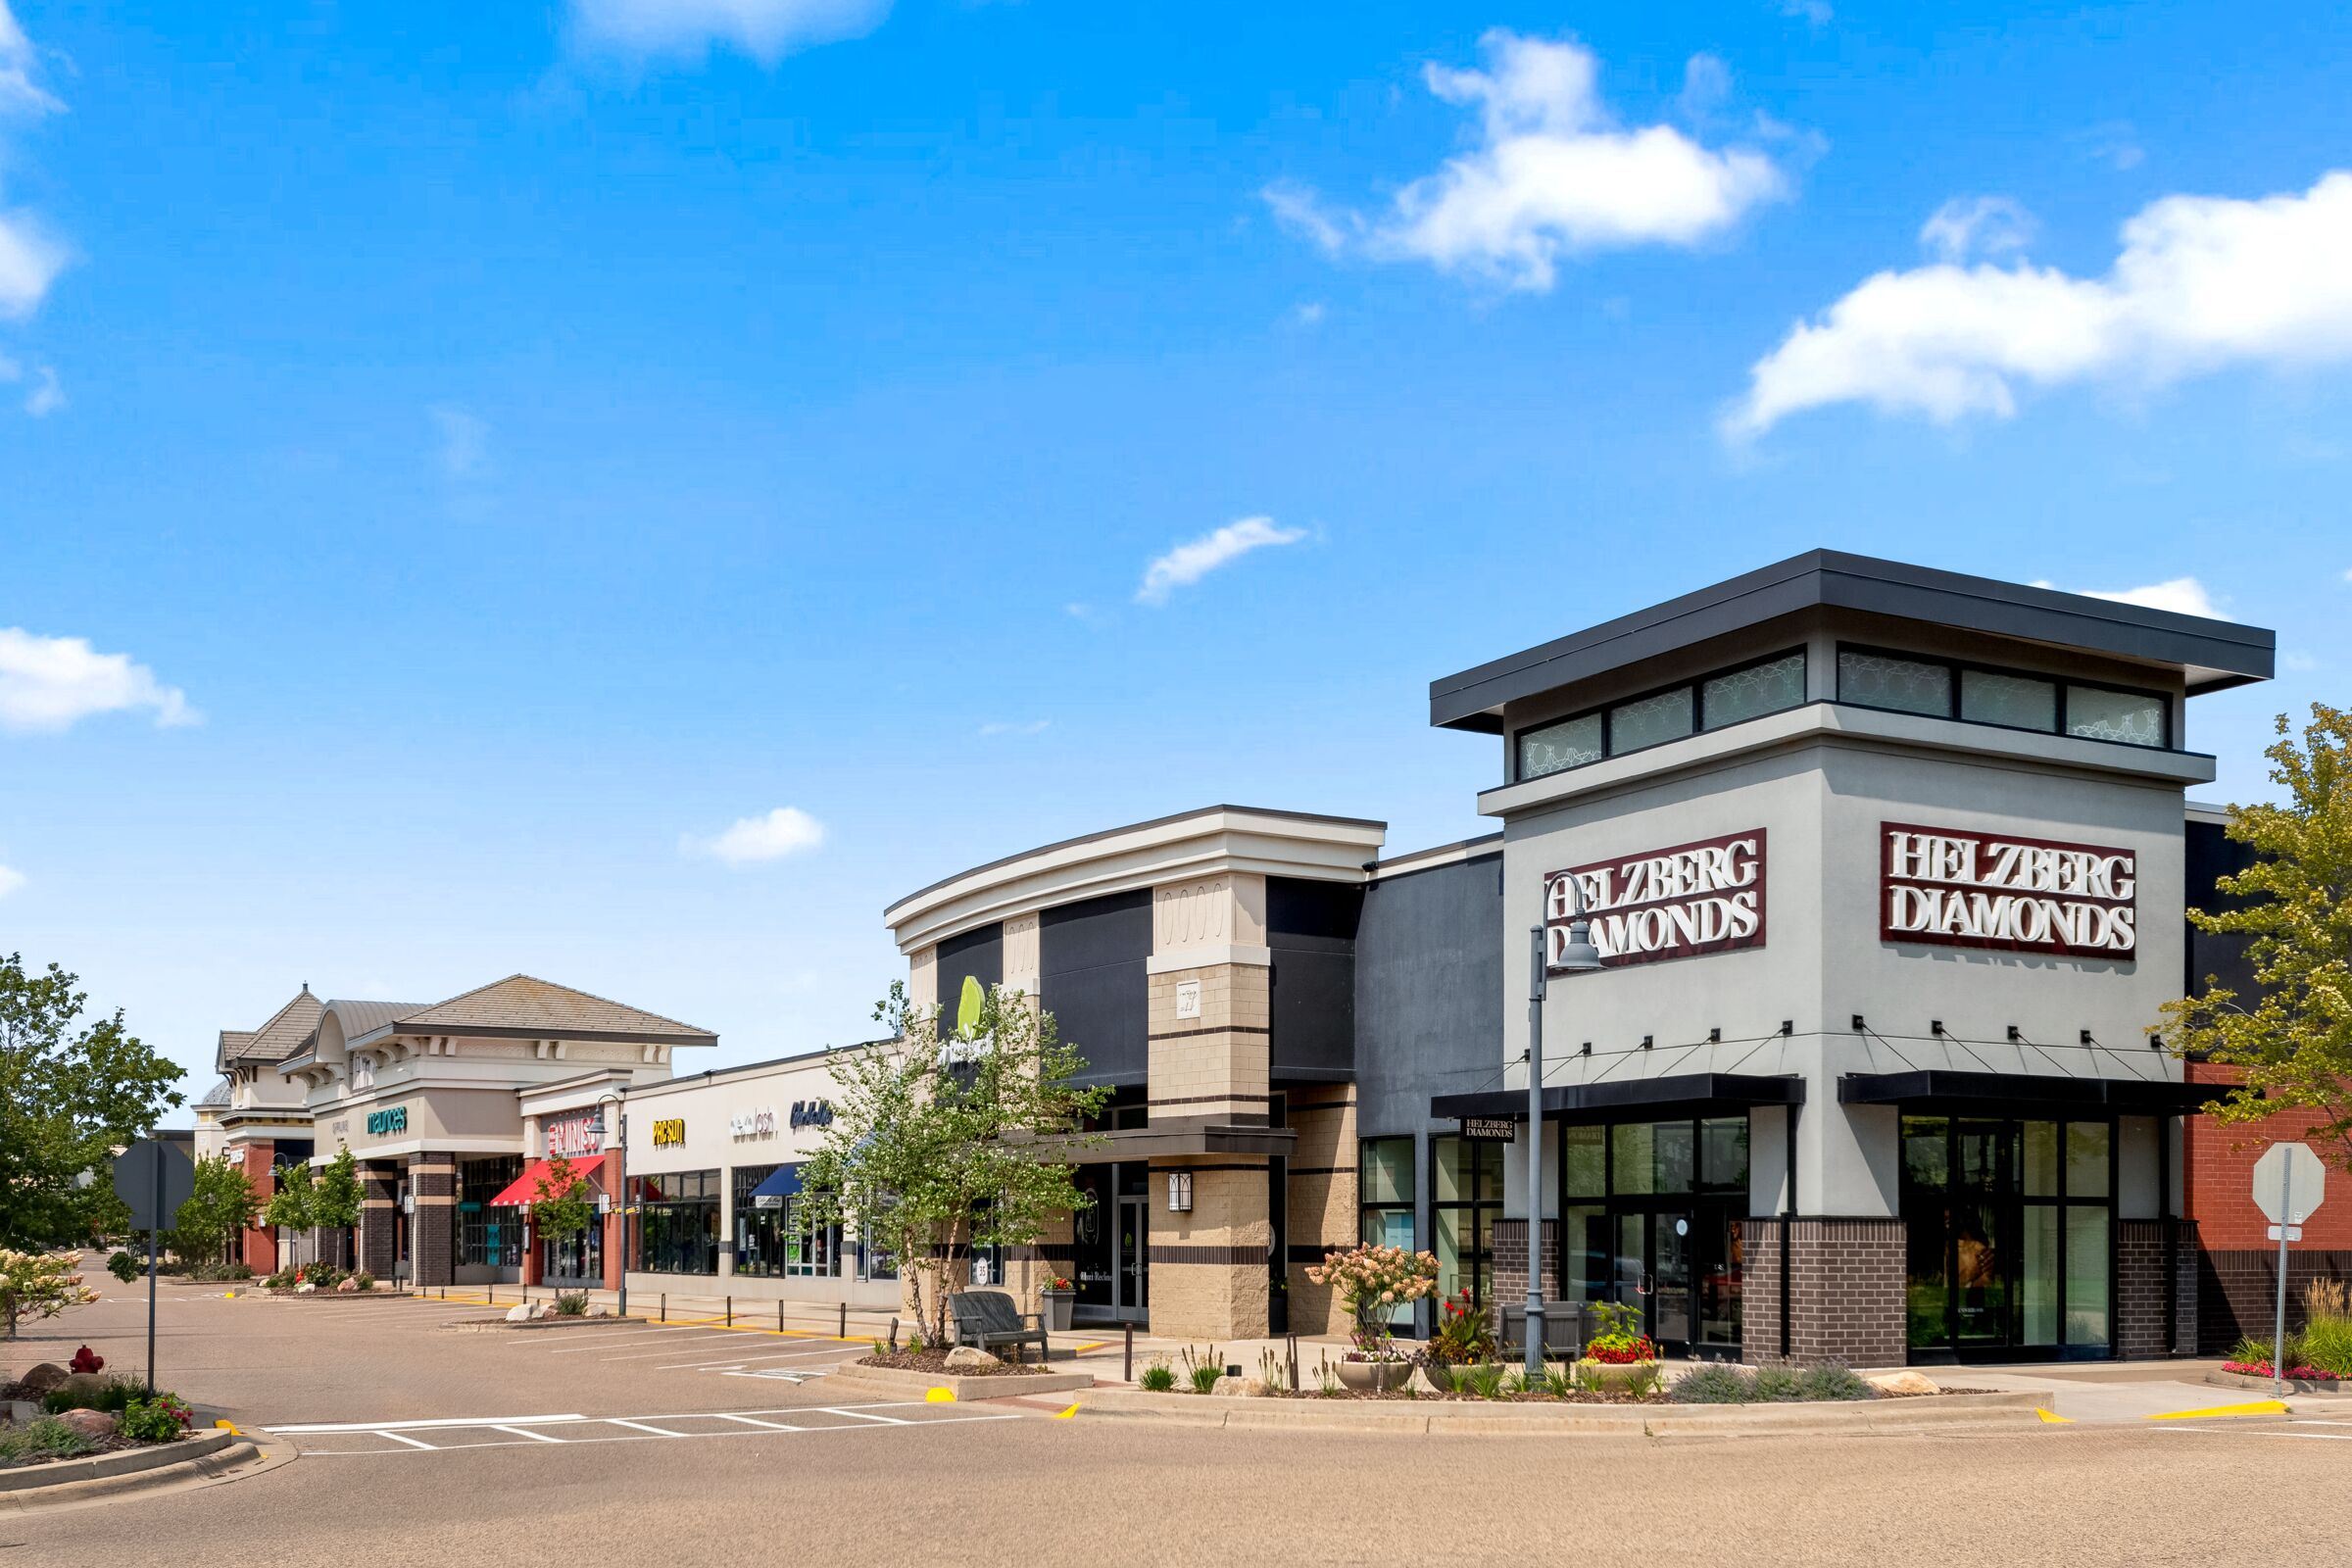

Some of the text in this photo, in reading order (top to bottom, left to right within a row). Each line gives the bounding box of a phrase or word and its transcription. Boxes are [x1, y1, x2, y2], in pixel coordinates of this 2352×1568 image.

[1544, 839, 1759, 920] HELZBERG
[1888, 831, 2135, 901] HELZBERG
[1547, 891, 1759, 966] DAMONDS
[1888, 885, 2135, 951] DIAMONDS
[367, 1106, 407, 1134] maurices
[1466, 1119, 1513, 1129] HELZBERG
[1466, 1128, 1513, 1138] DIAMONDS
